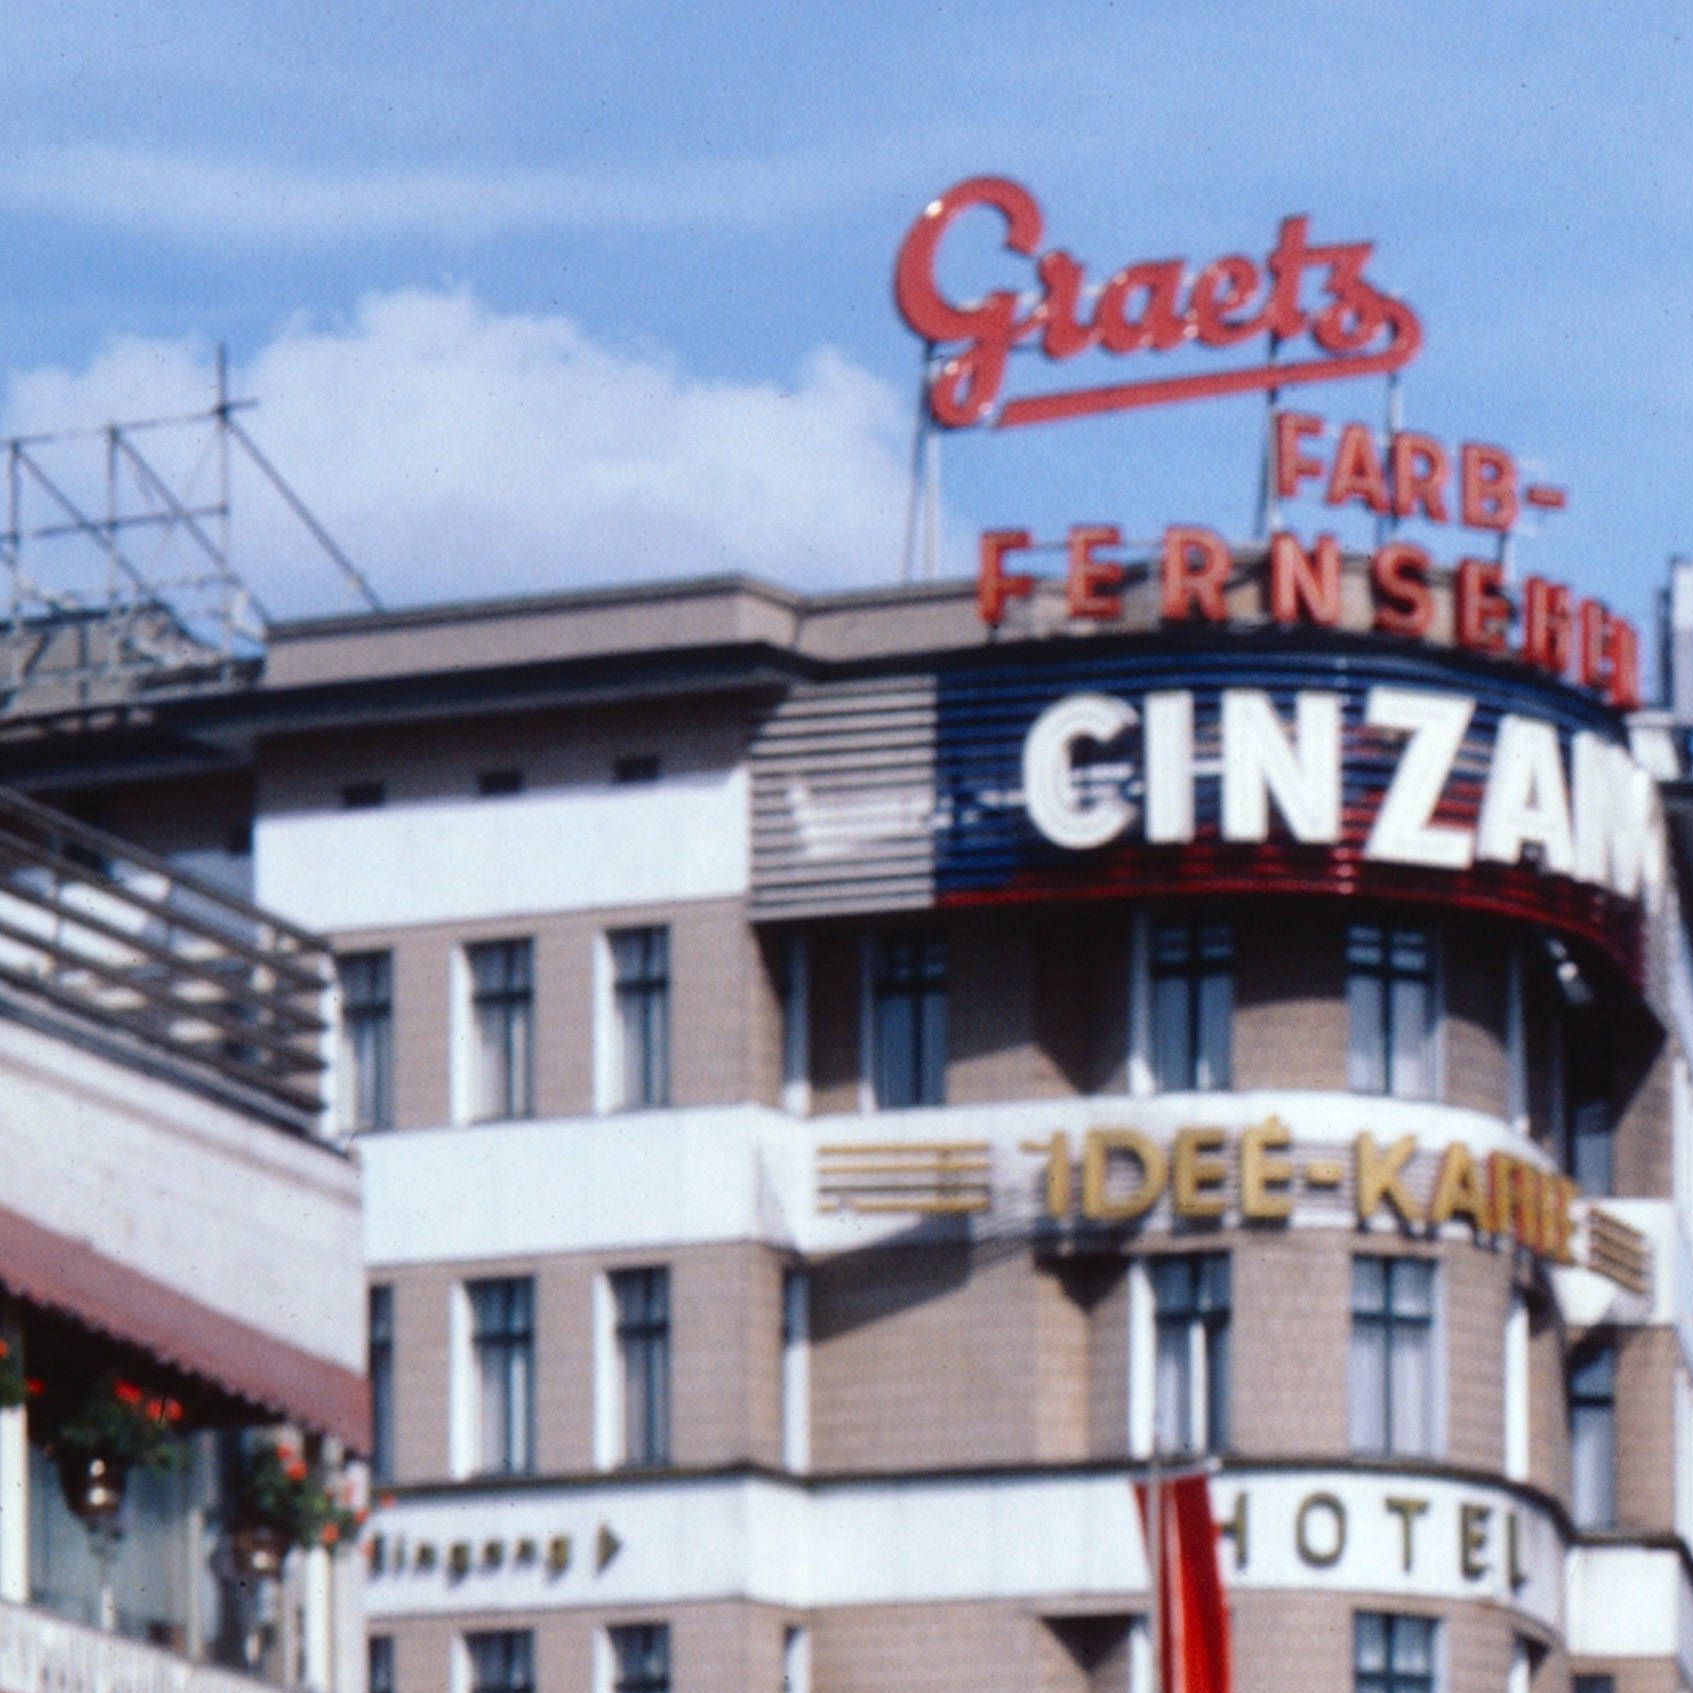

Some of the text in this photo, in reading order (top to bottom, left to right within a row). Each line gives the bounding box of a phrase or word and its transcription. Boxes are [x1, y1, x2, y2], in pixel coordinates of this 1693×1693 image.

[893, 175, 1423, 428] Graetz
[1272, 410, 1567, 532] FARB-
[1217, 1490, 1530, 1598] HOTEL
